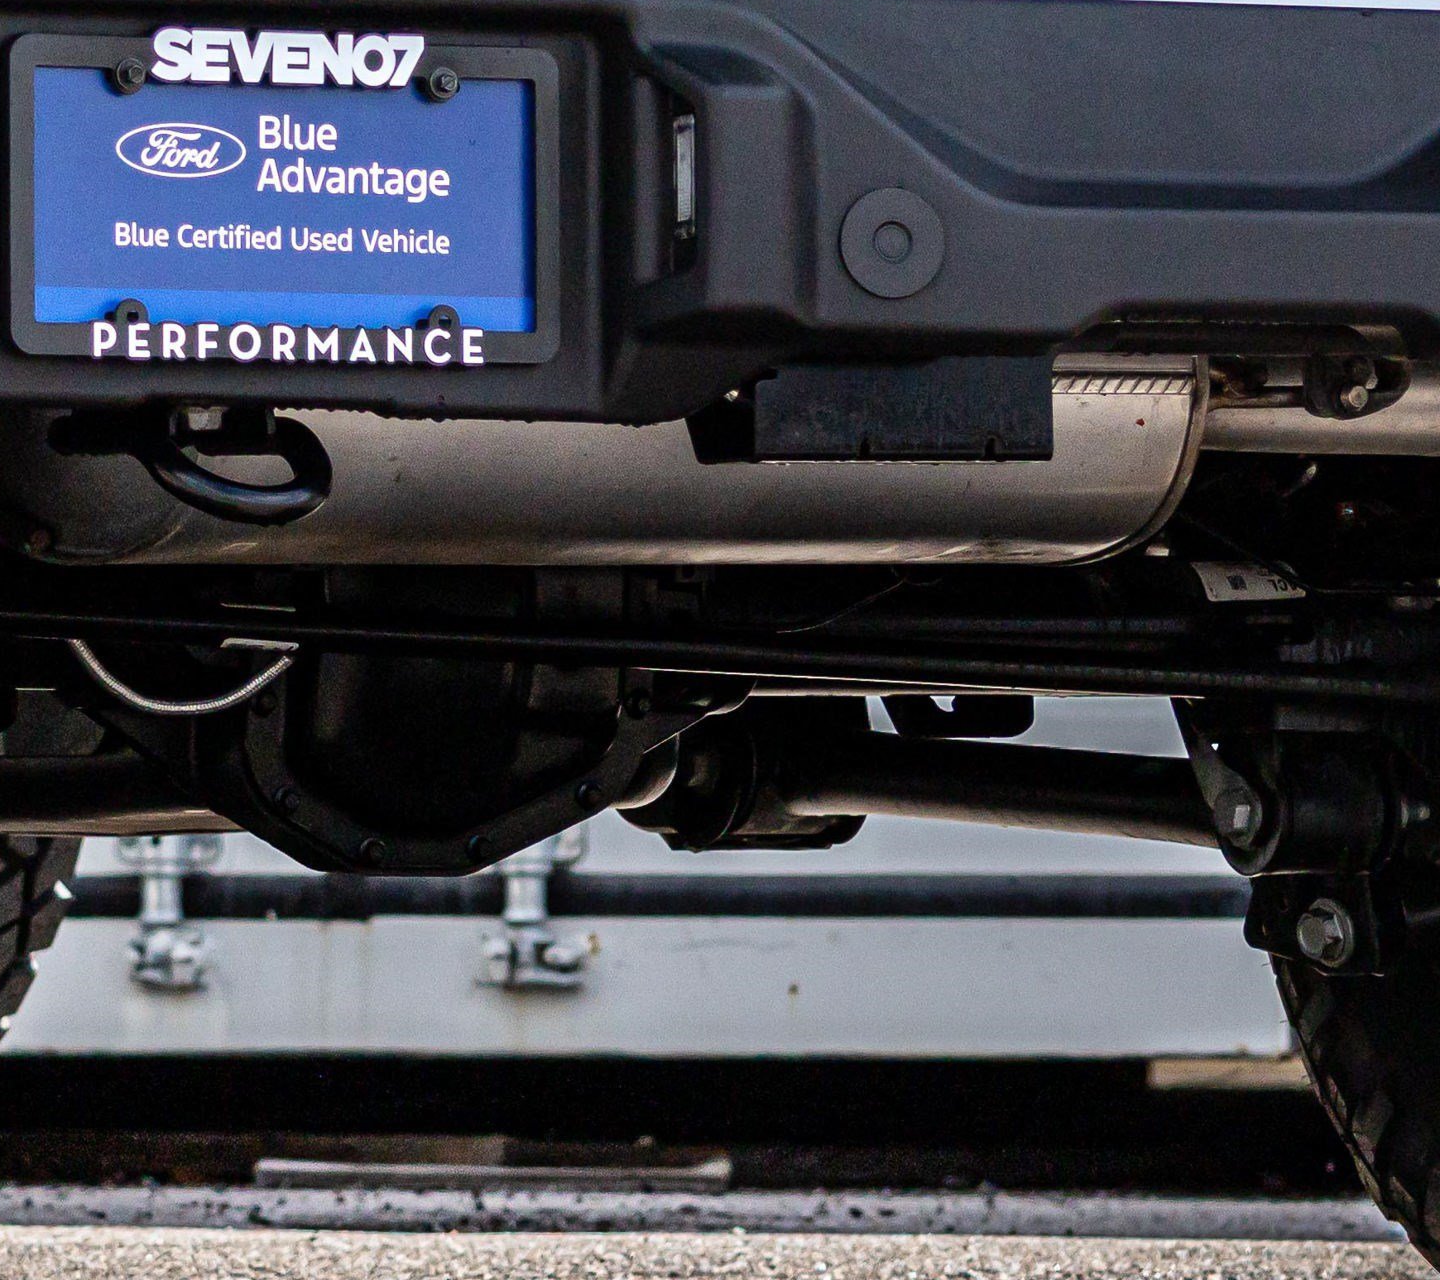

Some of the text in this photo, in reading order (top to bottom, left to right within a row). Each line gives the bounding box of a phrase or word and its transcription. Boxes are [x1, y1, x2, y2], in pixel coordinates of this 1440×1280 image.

[258, 115, 338, 152] Blue
[257, 158, 451, 203] Advantage
[115, 223, 451, 255] Blue Certified Used Vehicle
[92, 322, 486, 366] PERFORMANCE
